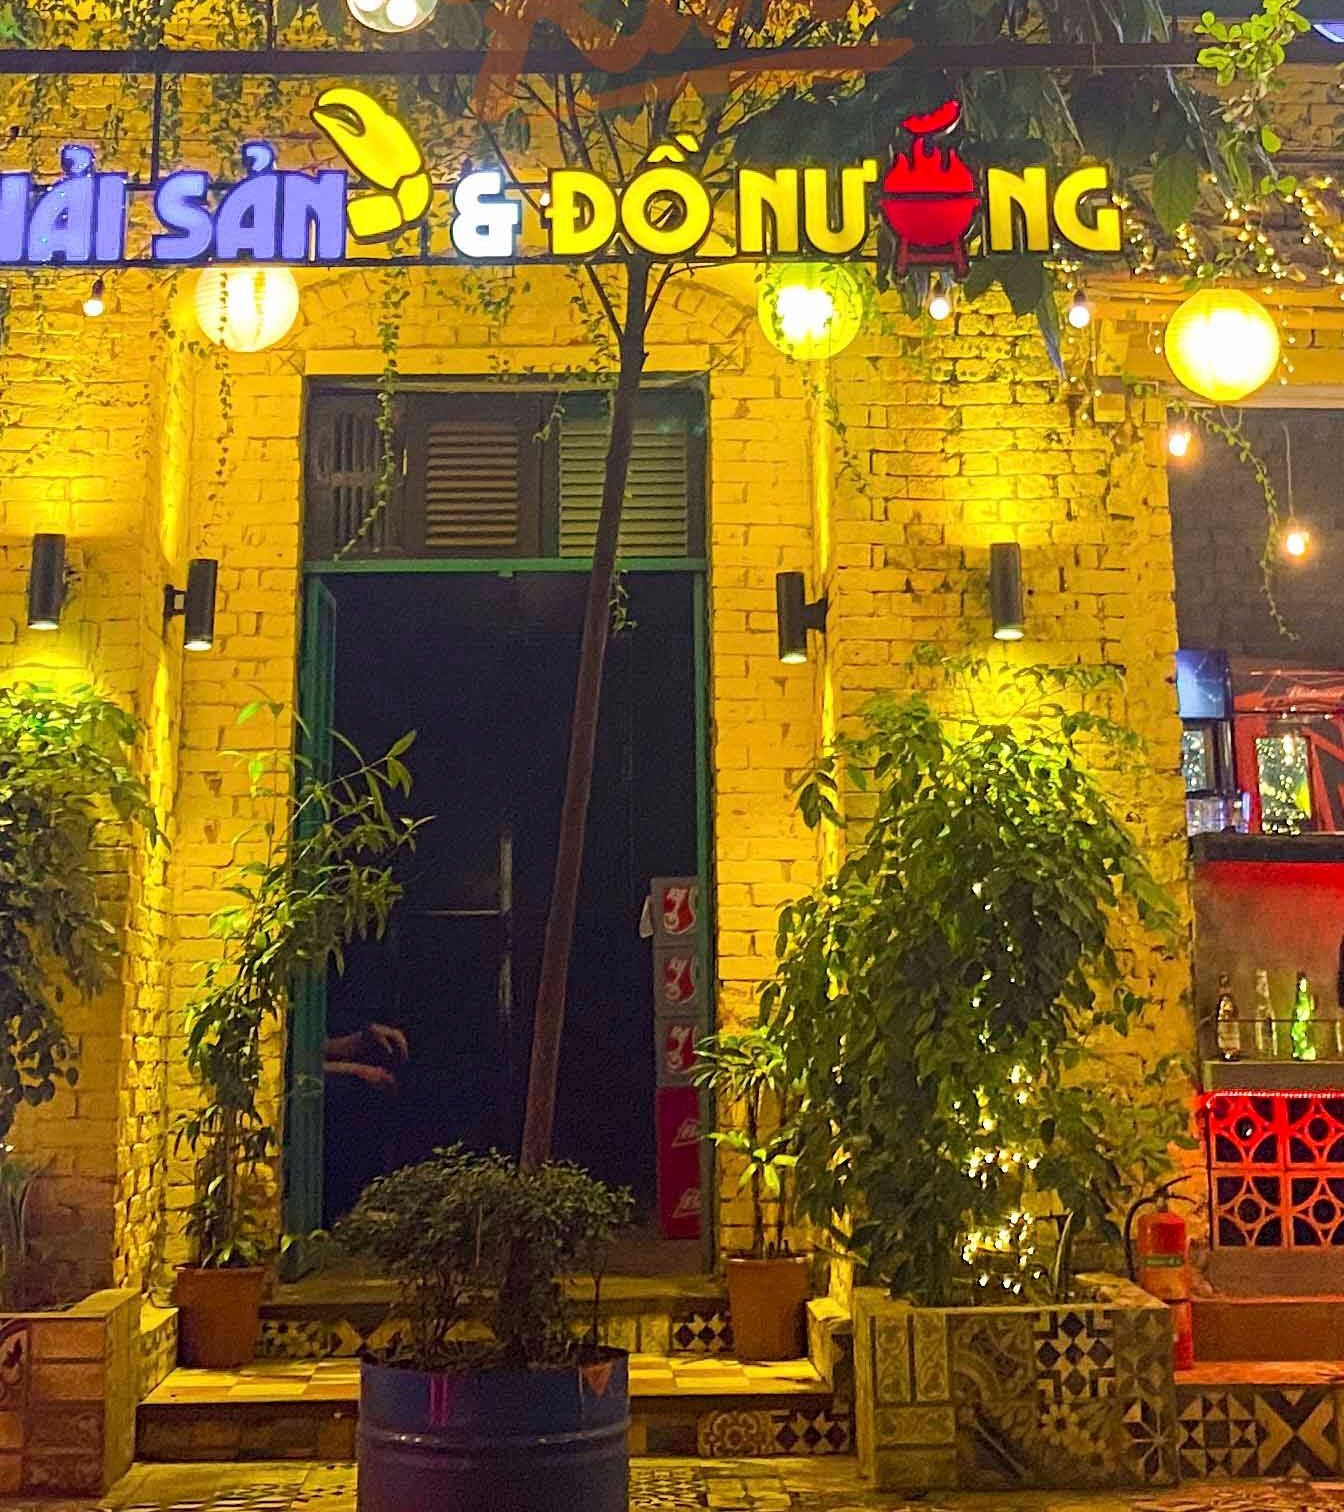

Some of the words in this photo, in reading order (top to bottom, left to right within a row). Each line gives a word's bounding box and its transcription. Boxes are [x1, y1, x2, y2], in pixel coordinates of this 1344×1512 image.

[156, 142, 347, 262] SẢN
[453, 170, 520, 258] &
[545, 134, 712, 256] ĐỒ
